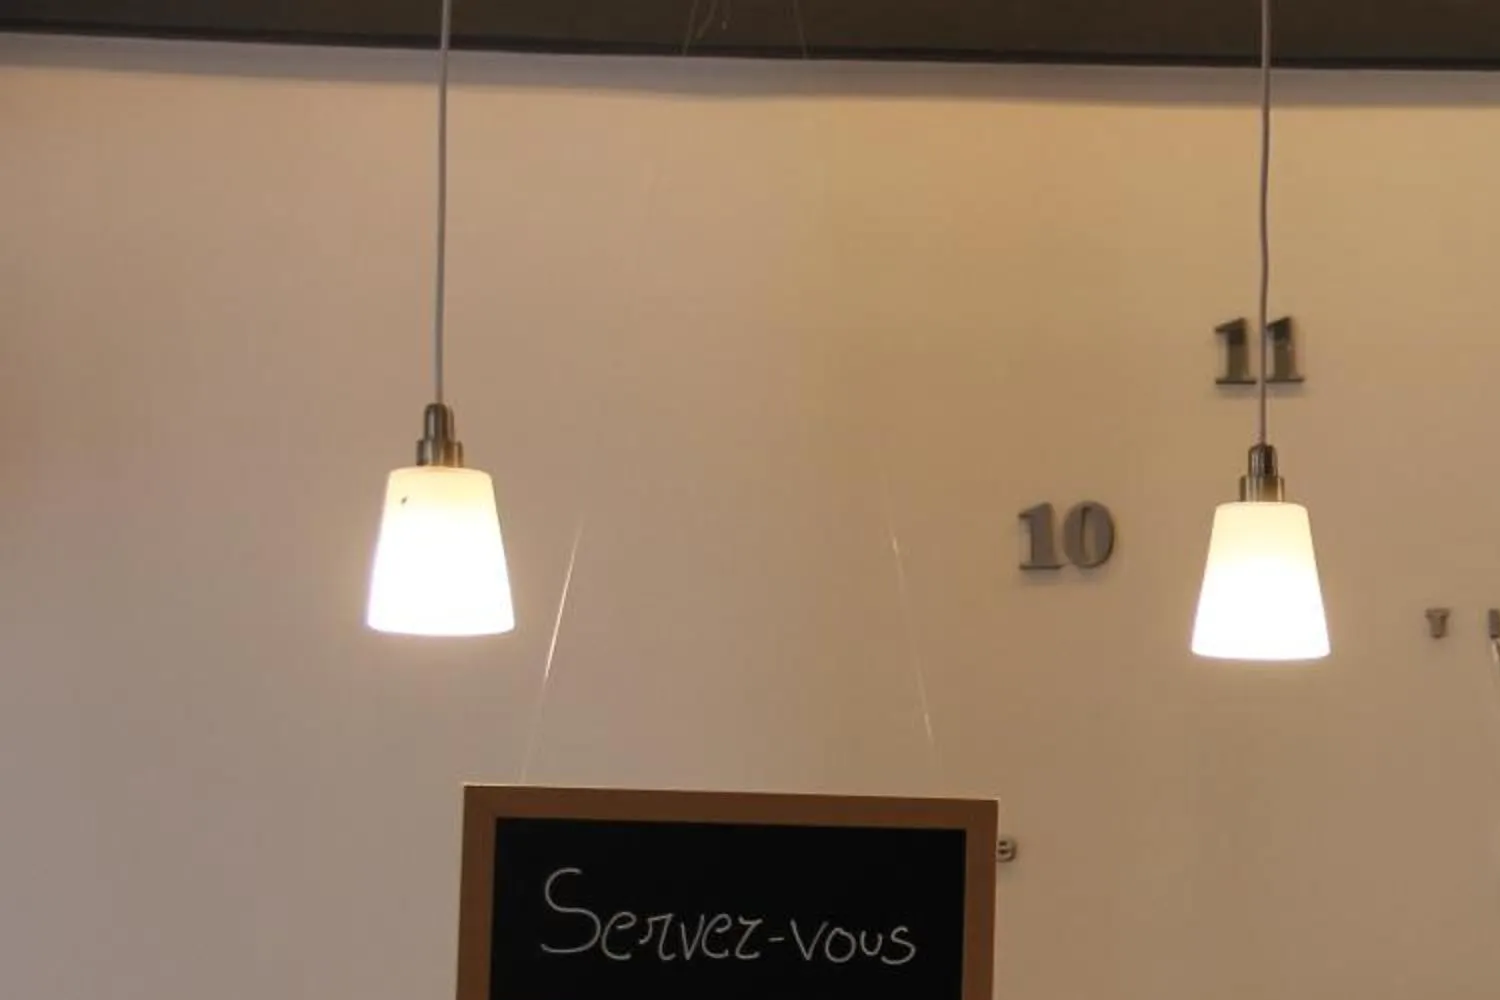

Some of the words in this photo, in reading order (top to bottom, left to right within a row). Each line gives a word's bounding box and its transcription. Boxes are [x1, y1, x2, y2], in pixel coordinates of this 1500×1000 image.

[1214, 316, 1305, 385] 11
[1018, 501, 1115, 570] 10
[540, 867, 917, 965] Servez-vous
